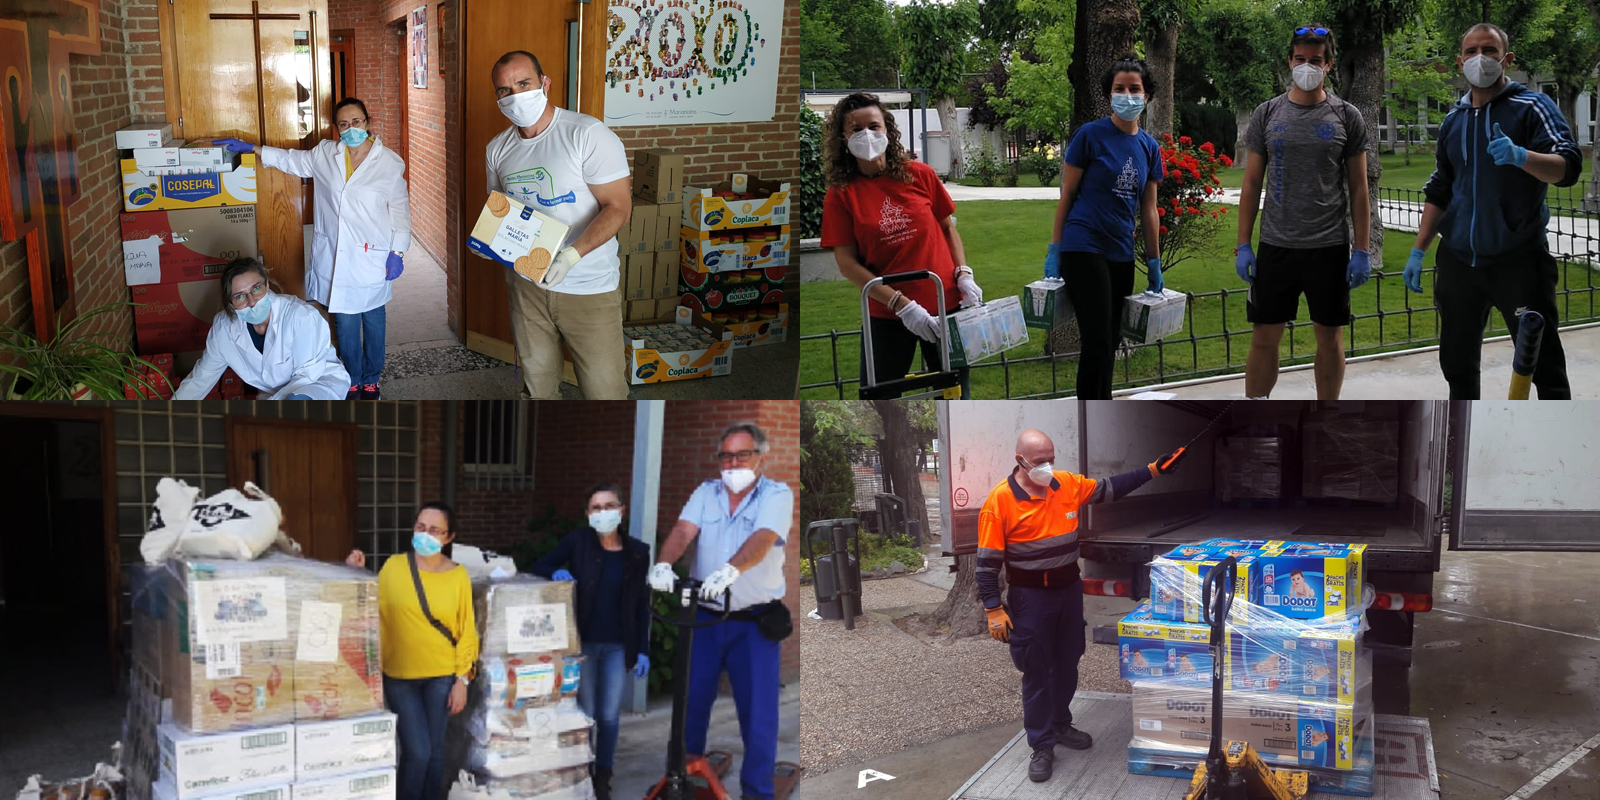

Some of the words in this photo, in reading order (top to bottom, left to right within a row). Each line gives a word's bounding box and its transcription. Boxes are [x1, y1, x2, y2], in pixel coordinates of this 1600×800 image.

[167, 179, 216, 191] COSEPAL
[733, 215, 759, 225] Coplaca
[505, 224, 529, 240] GALLETAS
[220, 250, 241, 259] 001
[729, 291, 757, 300] BOUQUET
[733, 333, 756, 342] Coplaca
[668, 367, 698, 377] Coplaca
[1282, 595, 1318, 607] DODOT
[1129, 665, 1149, 673] DODOT
[1166, 699, 1207, 712] DODOT
[1200, 716, 1206, 724] 3
[1285, 723, 1292, 732] 3
[1305, 725, 1313, 748] DODOT
[857, 768, 897, 789] A
